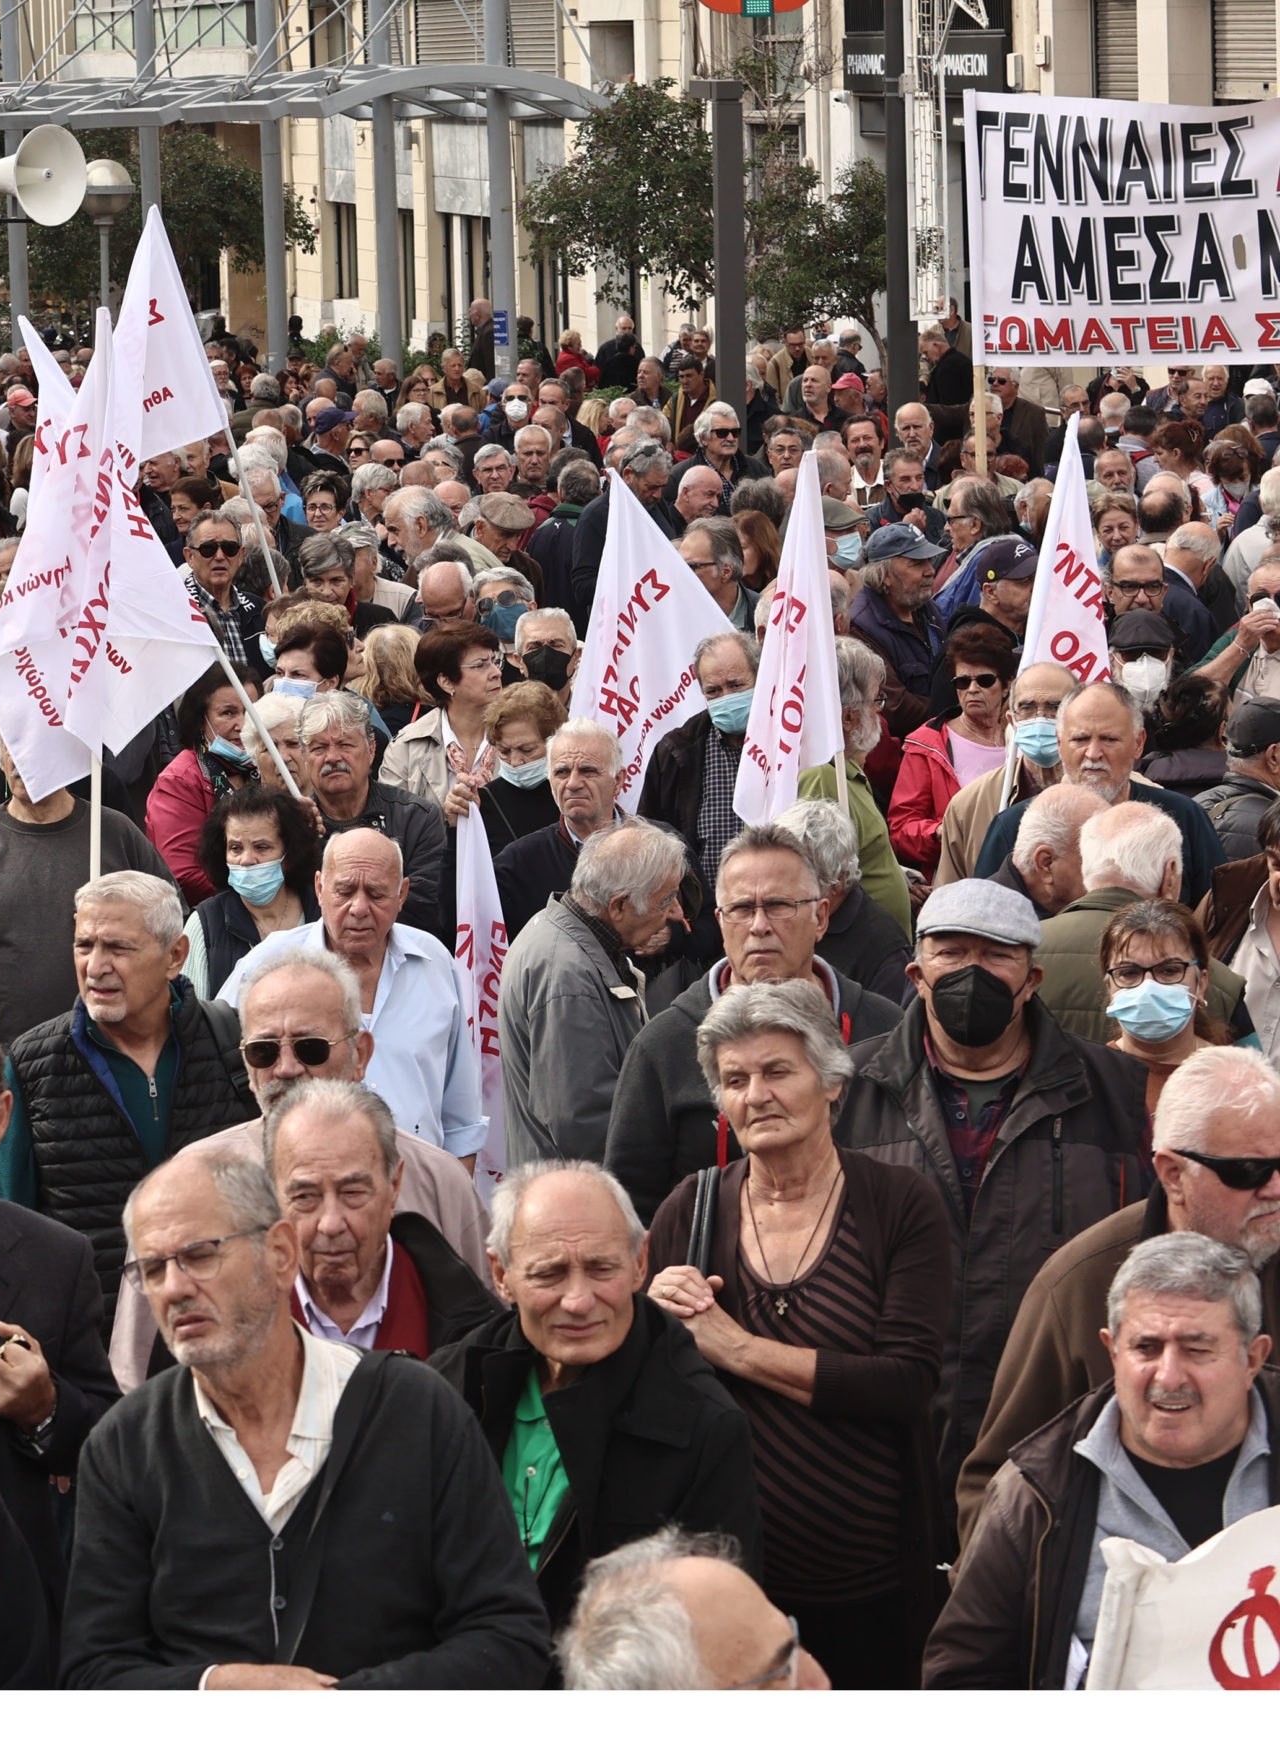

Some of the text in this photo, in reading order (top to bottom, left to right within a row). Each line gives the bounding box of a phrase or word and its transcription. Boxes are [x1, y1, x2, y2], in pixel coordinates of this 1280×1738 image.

[846, 53, 886, 75] PHARMAC
[931, 53, 988, 76] ΡΜΑΚΕΙΟΝ
[1011, 211, 1235, 305] ΑΜΕΣΑ
